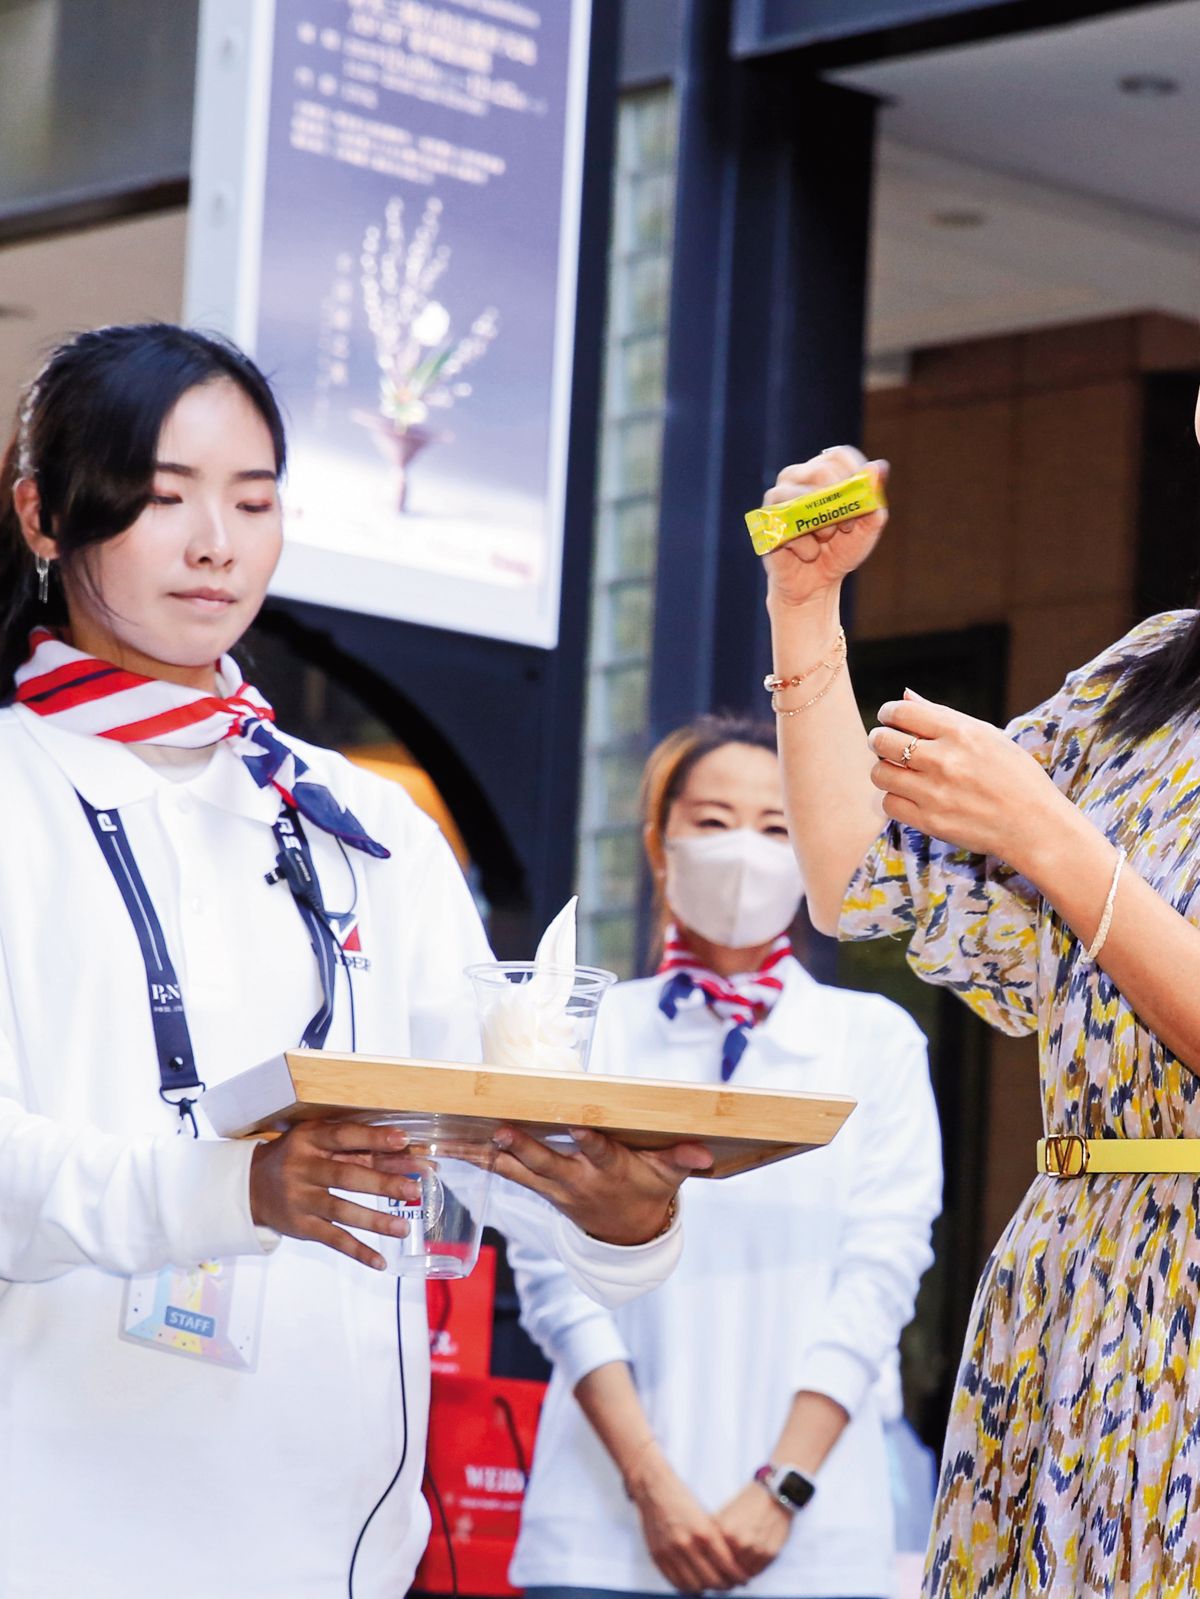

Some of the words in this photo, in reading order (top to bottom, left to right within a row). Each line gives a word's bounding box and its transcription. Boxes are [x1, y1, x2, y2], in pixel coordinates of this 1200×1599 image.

[796, 501, 861, 532] Probiotics
[390, 1210, 430, 1220] EIDER
[169, 1311, 211, 1332] STAFF
[465, 1465, 526, 1493] WEID
